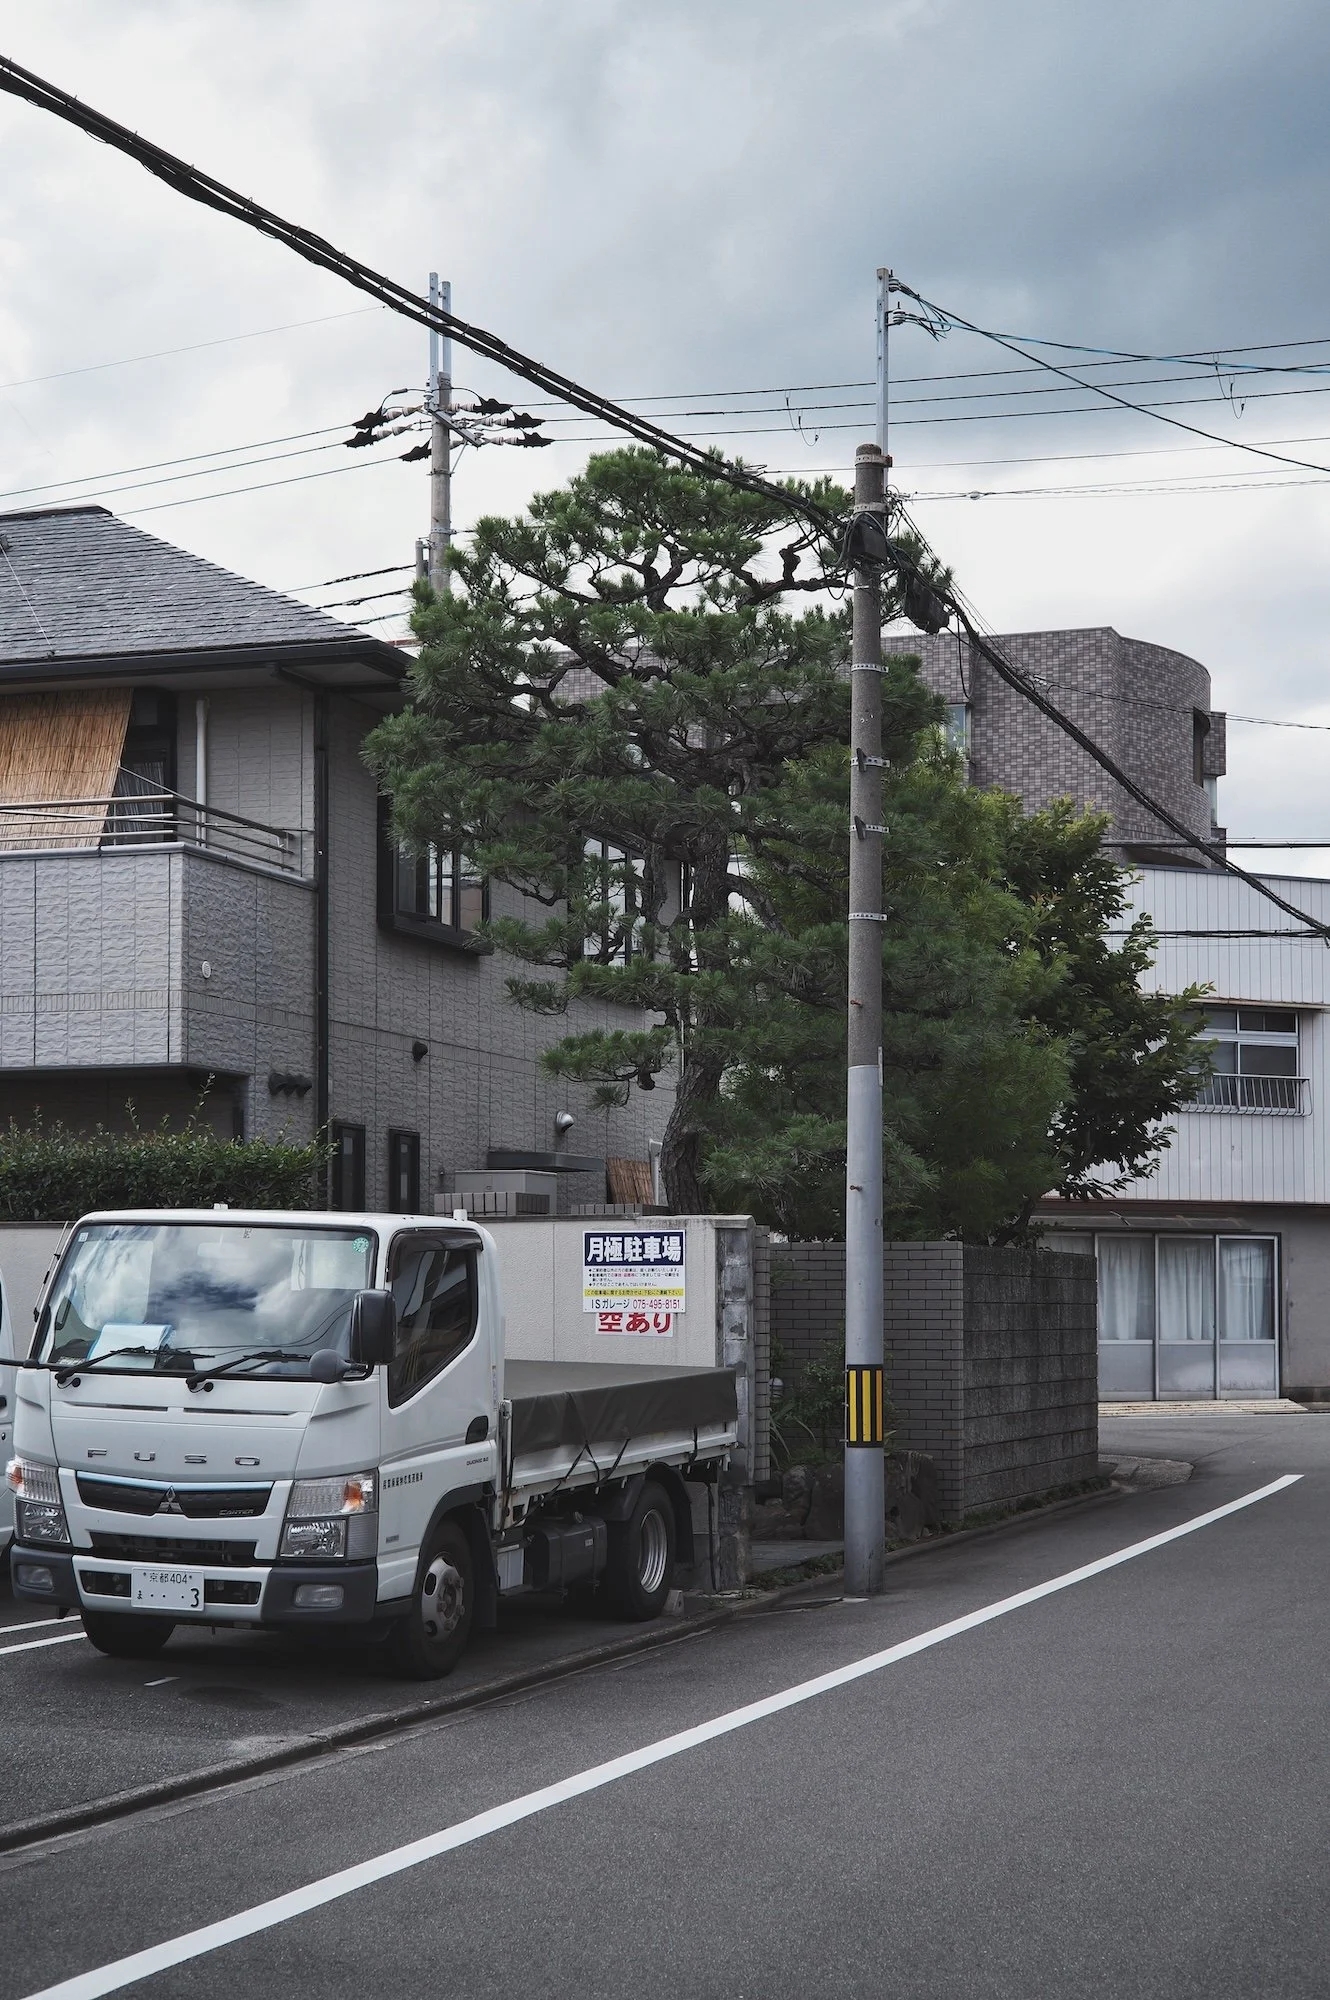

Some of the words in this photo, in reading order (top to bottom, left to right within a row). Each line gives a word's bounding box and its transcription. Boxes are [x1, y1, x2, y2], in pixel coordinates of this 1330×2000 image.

[587, 1235, 682, 1263] 月極駐車場
[632, 1299, 680, 1309] 075-495-8151
[598, 1312, 671, 1334] 空あり
[87, 1448, 261, 1466] FUSO
